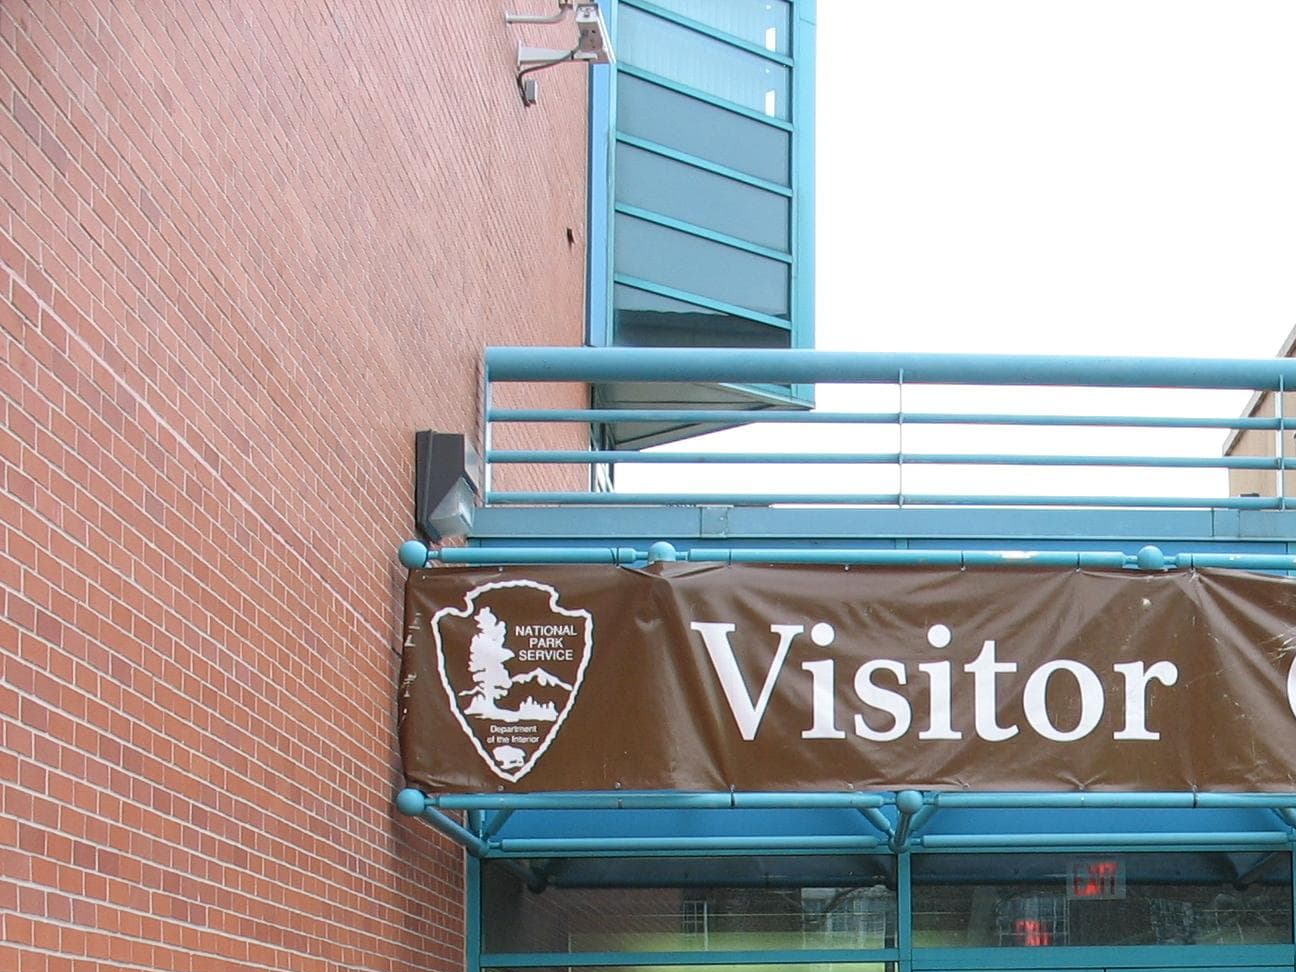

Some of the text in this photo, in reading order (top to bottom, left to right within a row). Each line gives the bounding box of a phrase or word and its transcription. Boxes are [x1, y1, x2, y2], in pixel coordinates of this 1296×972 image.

[515, 625, 577, 637] NATIONAL
[529, 637, 563, 648] PARK
[518, 649, 573, 661] SERVICE
[690, 621, 1180, 743] Visitor
[490, 725, 537, 735] Department
[487, 735, 539, 744] of the Interior
[1075, 863, 1117, 896] EXIT
